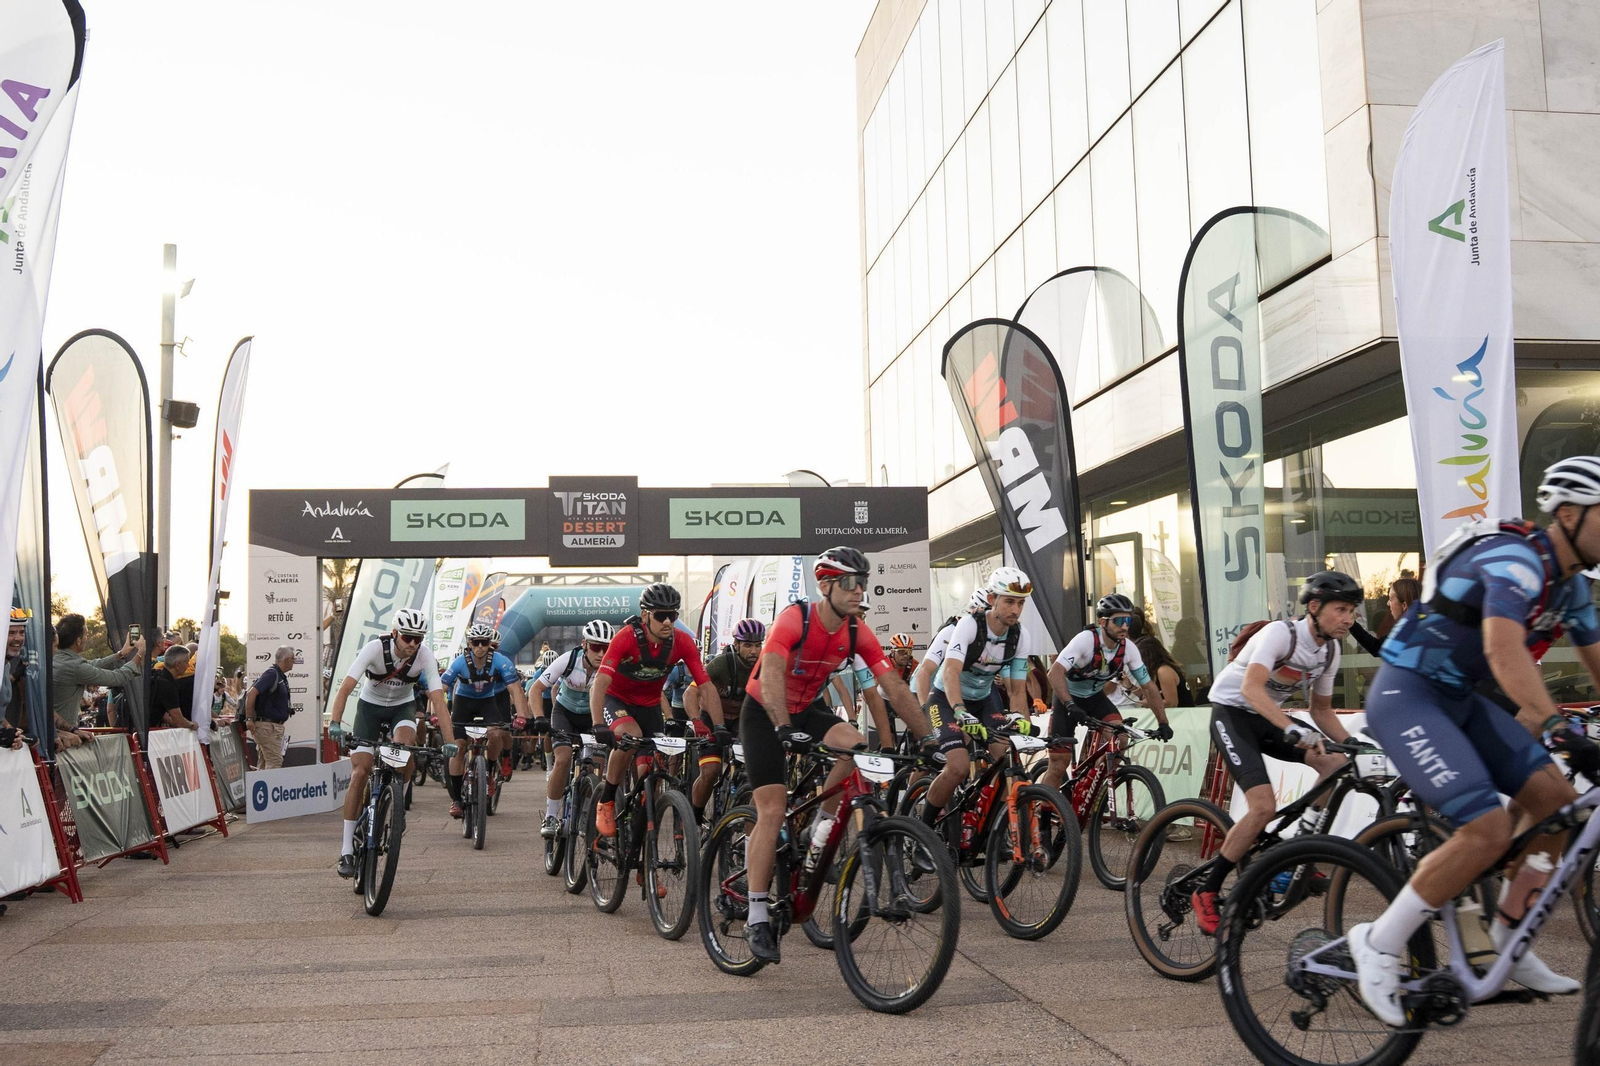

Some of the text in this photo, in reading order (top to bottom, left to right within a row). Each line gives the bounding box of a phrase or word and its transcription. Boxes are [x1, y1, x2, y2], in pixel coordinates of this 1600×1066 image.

[13, 163, 33, 274] Junta de Andalucía
[1466, 167, 1480, 266] Junta de Andalucía
[1432, 333, 1491, 521] dalucía
[301, 500, 374, 518] Andalucía
[553, 492, 627, 517] TITAN
[563, 522, 627, 533] DESERT
[815, 526, 861, 535] DIPUTACIÓN
[875, 526, 908, 535] ALMERÍA
[571, 536, 617, 546] ALMERÍA
[788, 555, 803, 604] Cleard
[546, 596, 631, 608] UNIVERSAE
[546, 608, 576, 616] Instituto
[578, 608, 608, 616] Superior
[929, 704, 943, 729] SEMAR
[389, 749, 400, 758] 38
[868, 757, 881, 767] 45
[1130, 744, 1193, 776] KODA
[1400, 724, 1460, 788] FANTÉ
[156, 750, 201, 799] MRW
[271, 780, 328, 803] Cleardent
